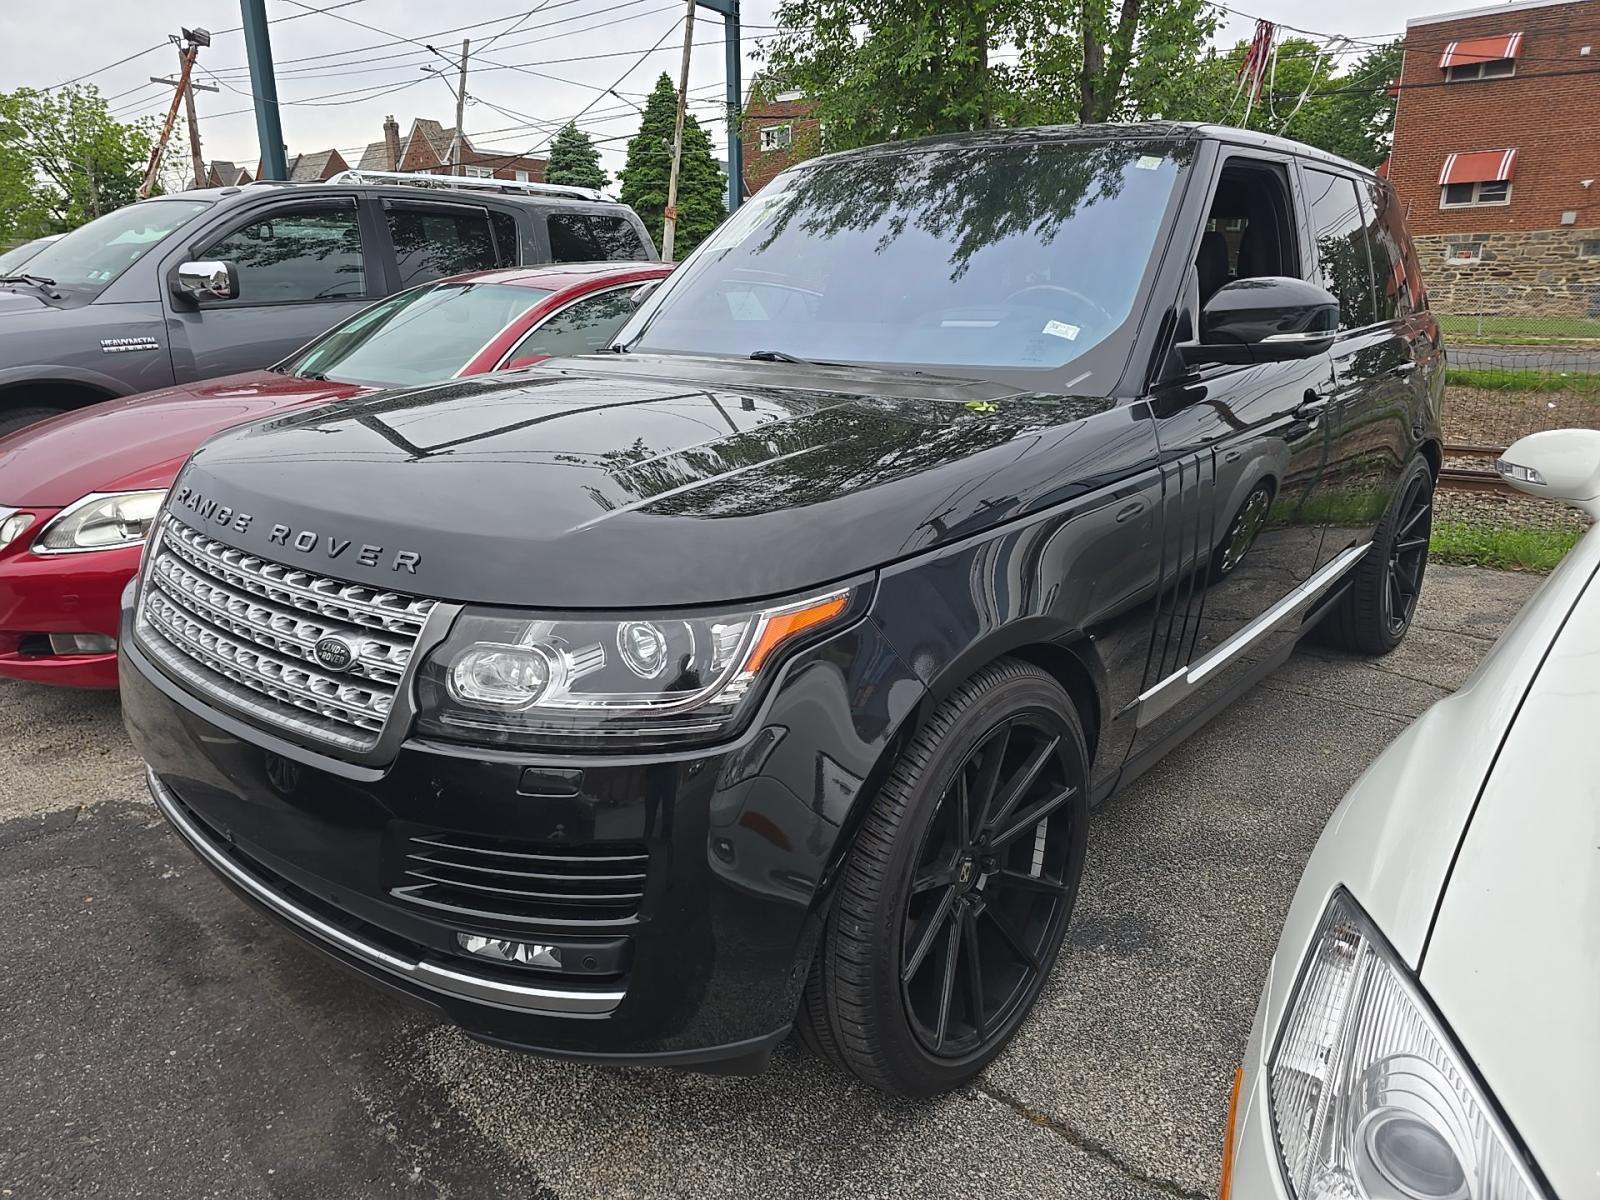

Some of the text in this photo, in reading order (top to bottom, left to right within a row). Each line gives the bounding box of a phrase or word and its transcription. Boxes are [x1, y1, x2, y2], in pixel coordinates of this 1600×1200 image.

[176, 487, 422, 575] RANGE ROVER
[321, 642, 341, 654] LAND
[321, 651, 345, 664] ROVER
